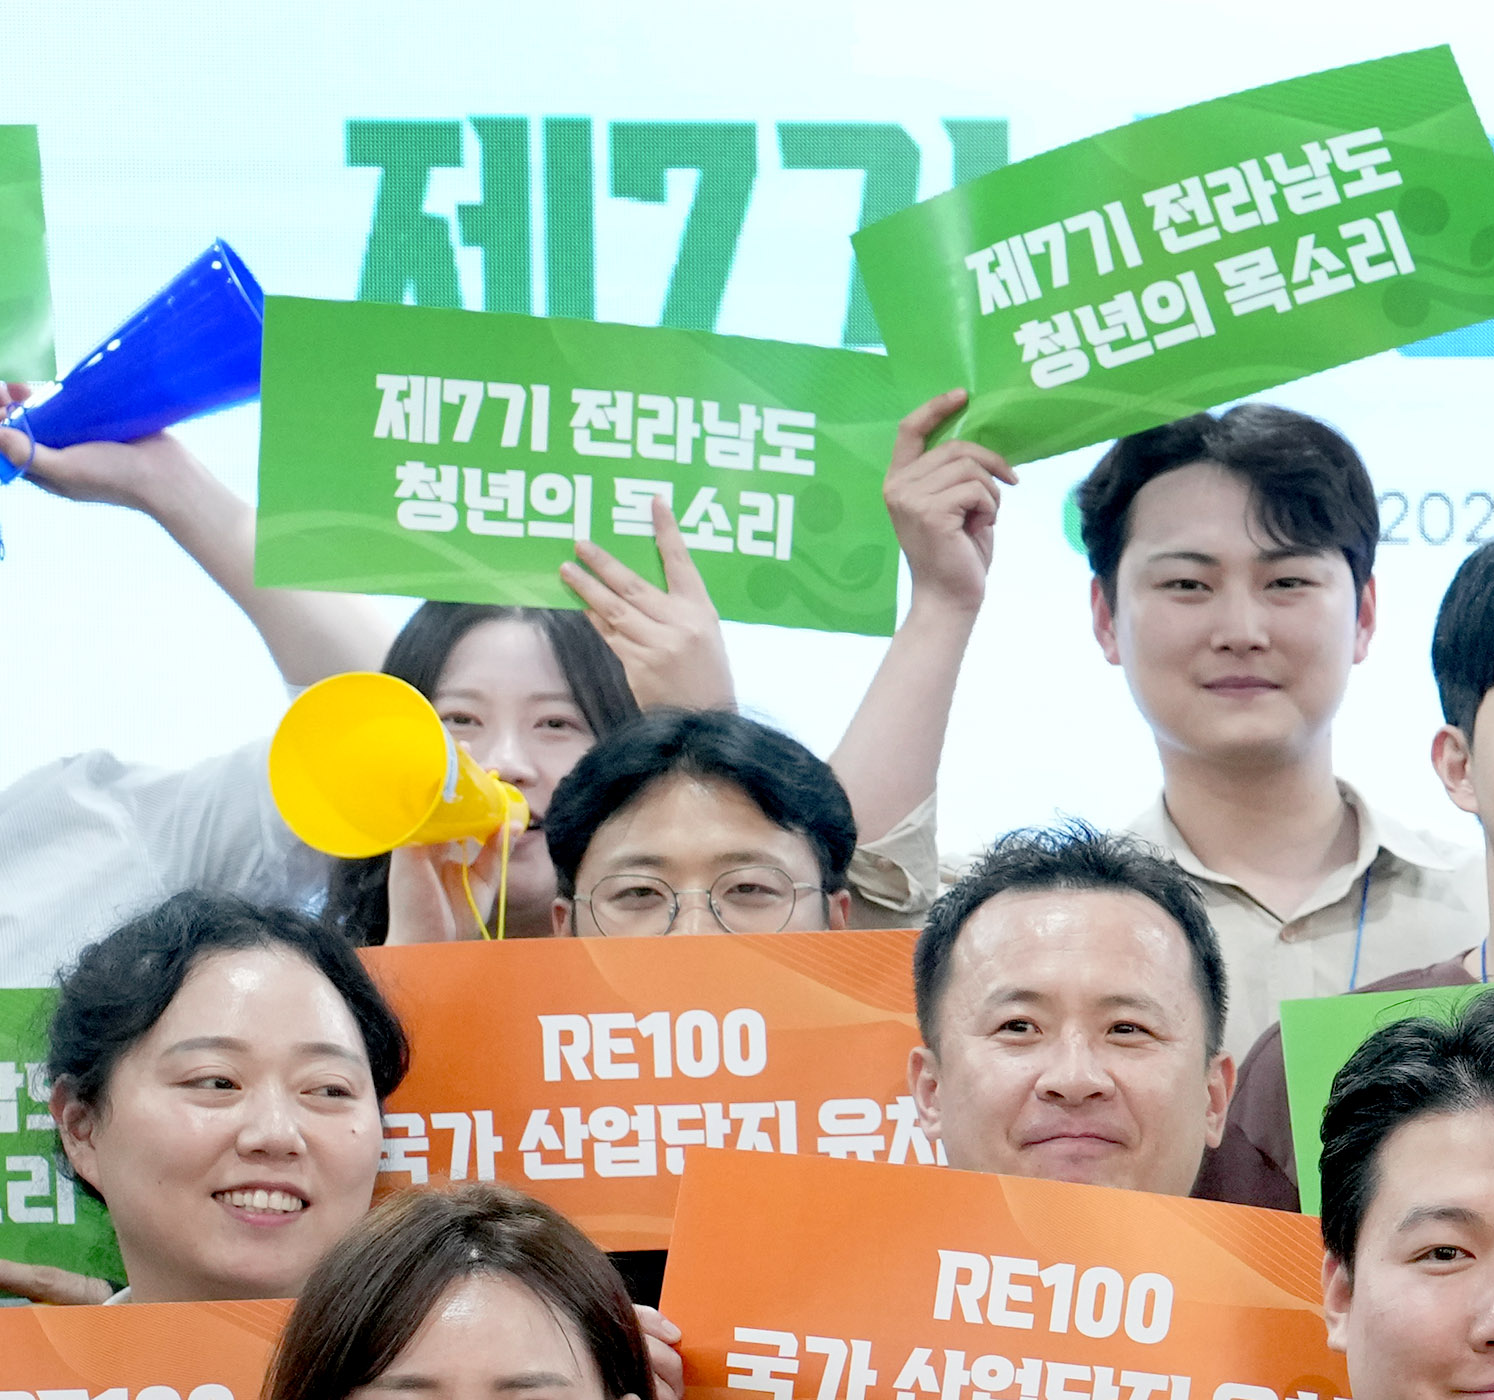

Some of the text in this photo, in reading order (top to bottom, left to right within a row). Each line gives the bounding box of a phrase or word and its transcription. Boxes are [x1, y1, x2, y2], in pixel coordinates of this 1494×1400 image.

[965, 127, 1402, 314] 제7기 전라남도
[1013, 210, 1416, 389] 청년의 목소리
[373, 373, 816, 476] 제7기 전라남도
[395, 464, 795, 561] 청년의 목소리
[538, 1009, 767, 1082] RE100
[380, 1110, 503, 1182] 국가
[518, 1100, 798, 1180] 산업단지
[933, 1249, 1174, 1345] RE100
